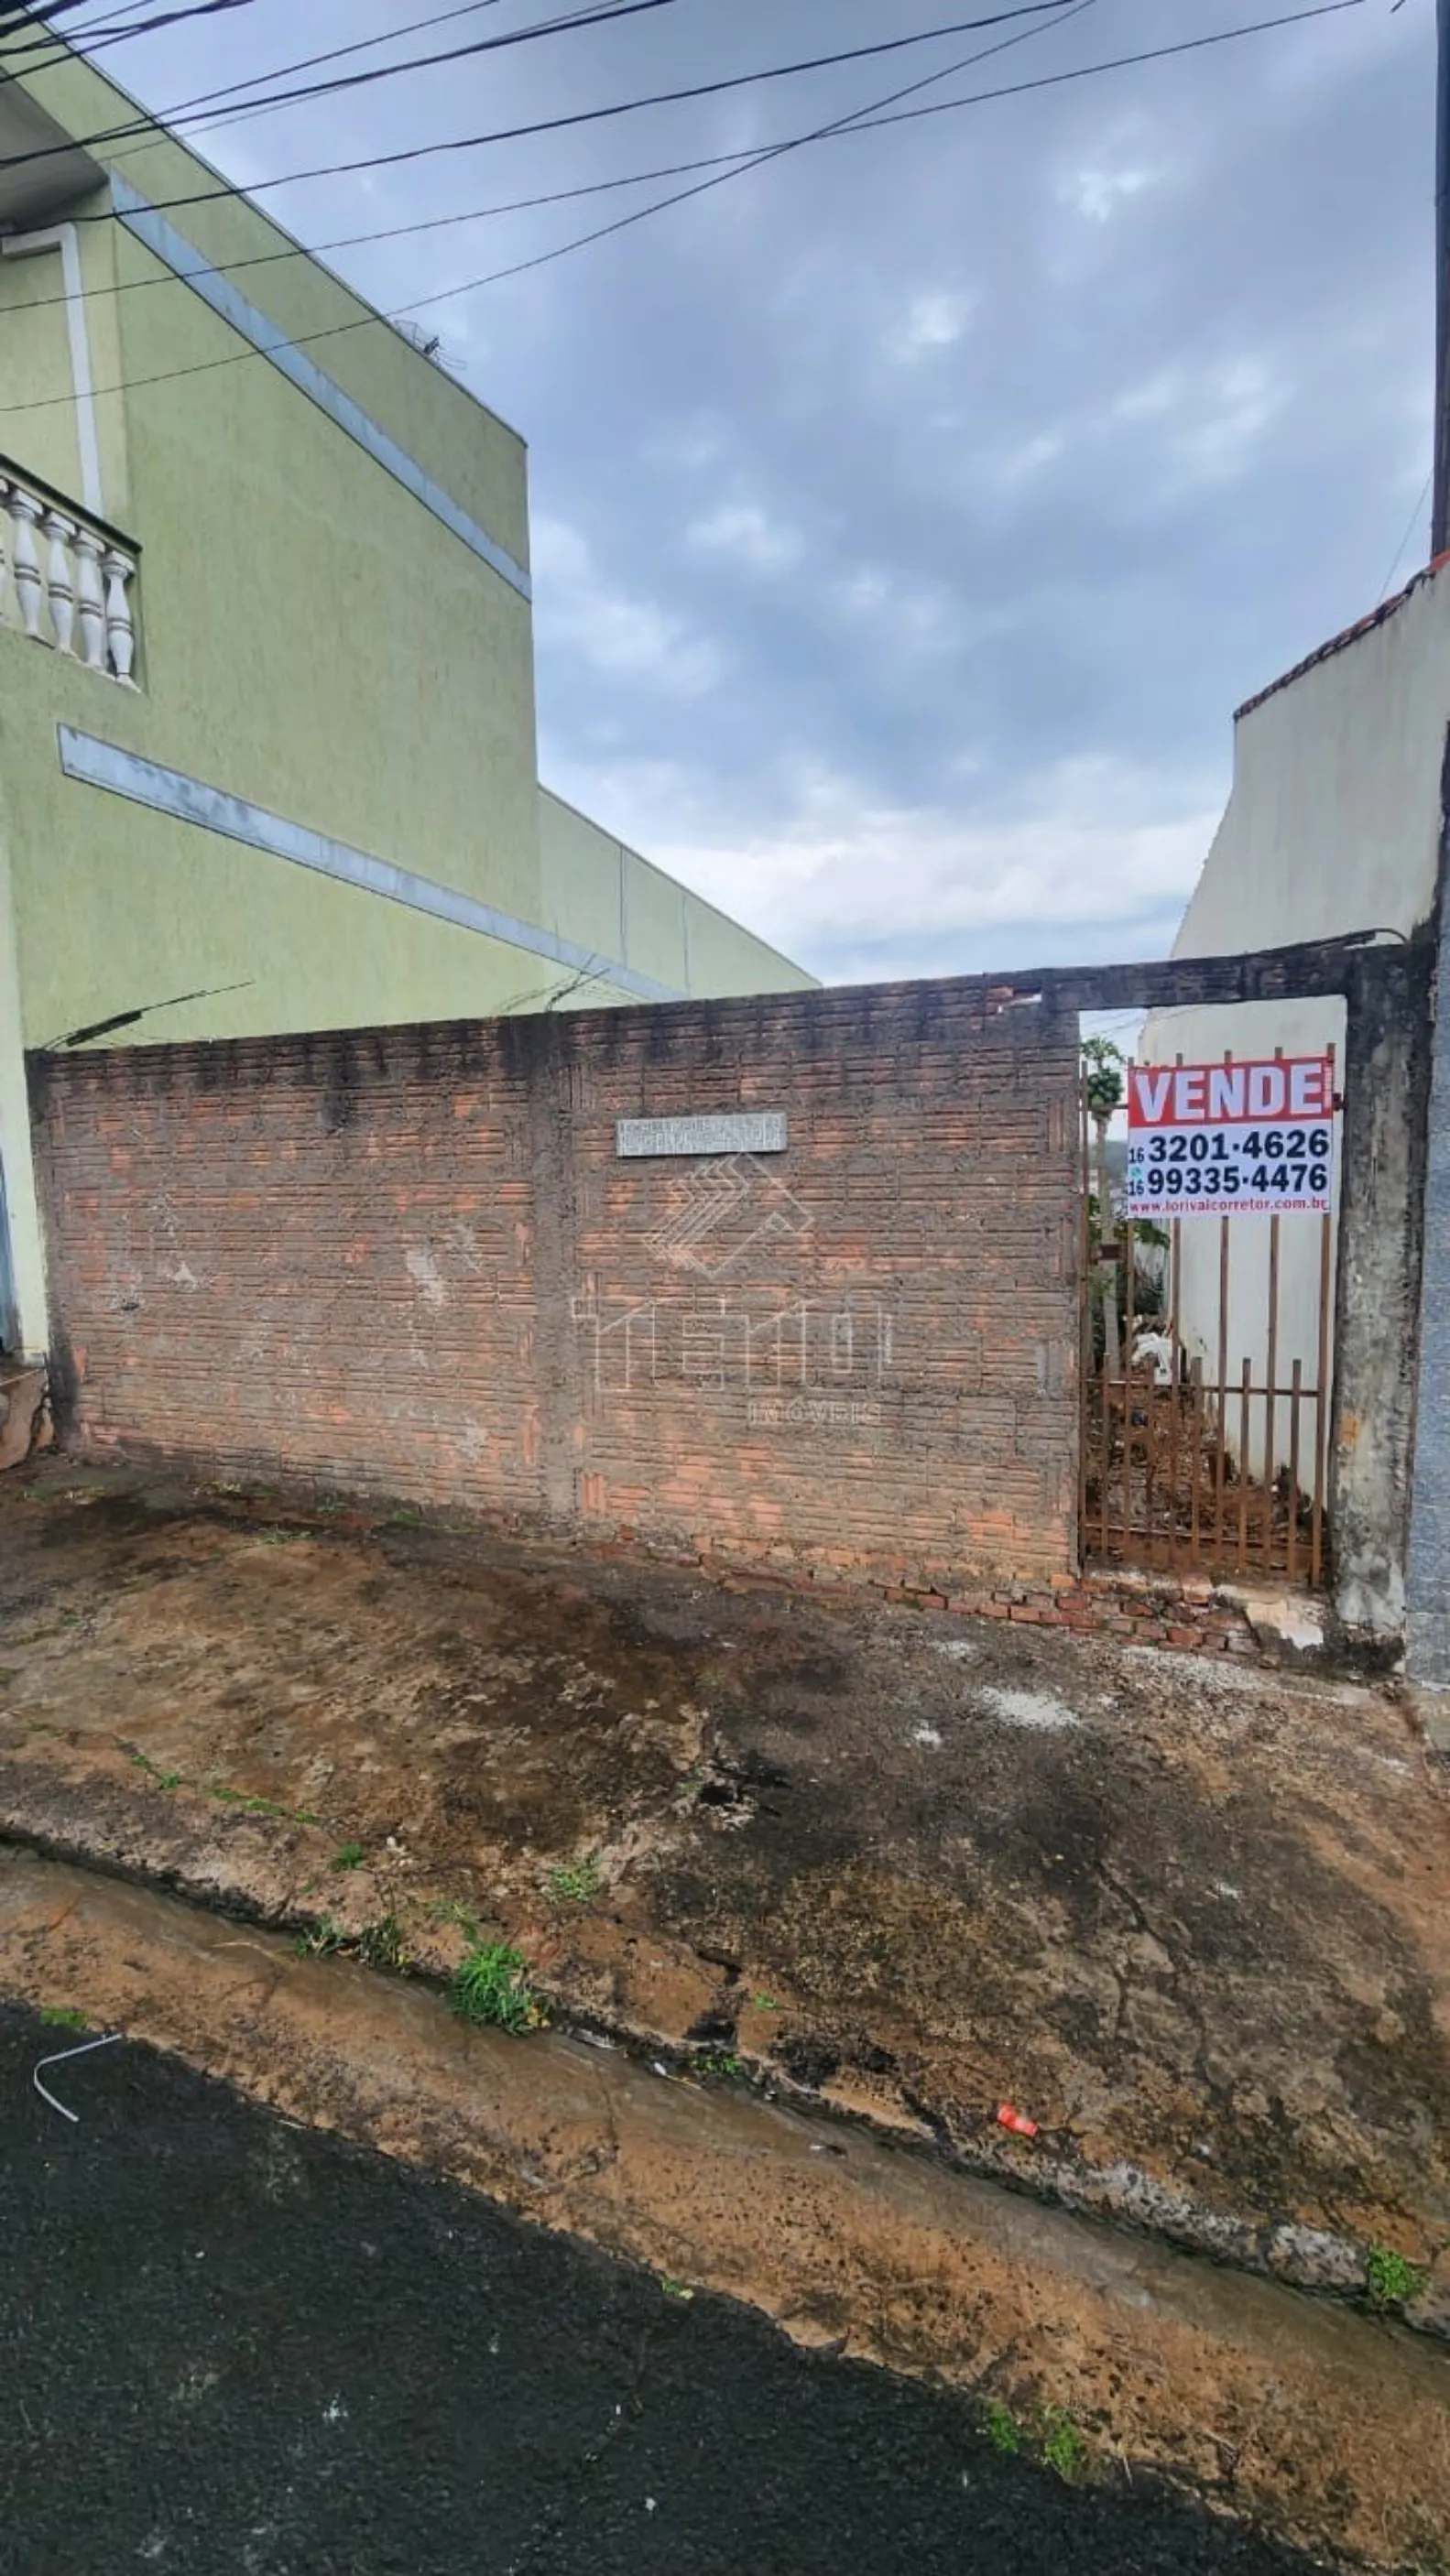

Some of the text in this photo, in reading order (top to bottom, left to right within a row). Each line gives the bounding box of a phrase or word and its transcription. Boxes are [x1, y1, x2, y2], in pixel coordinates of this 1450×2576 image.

[1135, 1062, 1323, 1122] VENDE
[1128, 1147, 1144, 1163] 16
[1128, 1179, 1145, 1196] 16
[1129, 1196, 1328, 1213] www.lorivalcorretor.com.br
